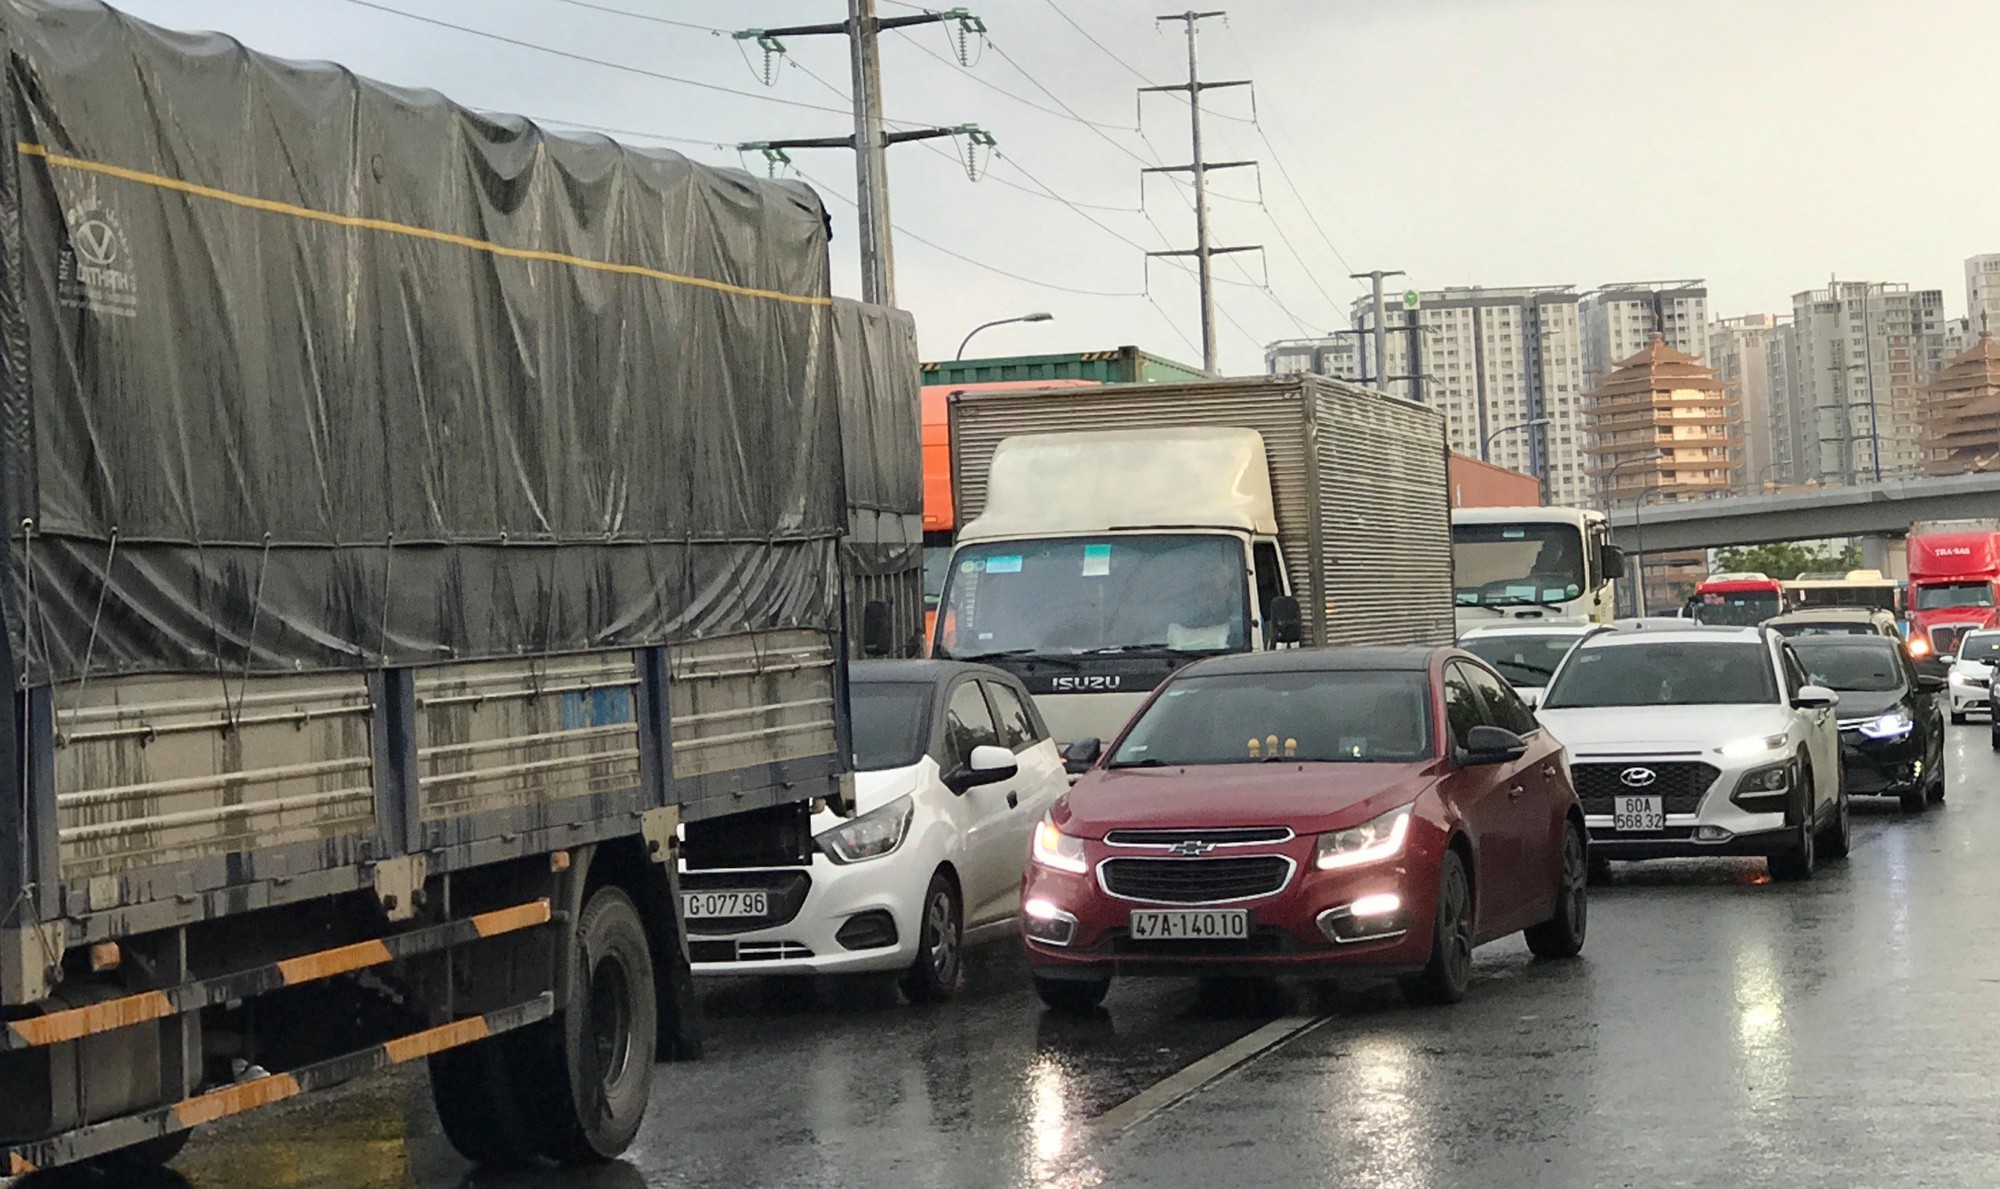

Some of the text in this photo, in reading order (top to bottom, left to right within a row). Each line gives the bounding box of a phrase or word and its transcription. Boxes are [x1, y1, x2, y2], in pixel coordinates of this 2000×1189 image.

[1052, 676, 1121, 692] ISUZU
[1626, 798, 1652, 813] 60A
[1136, 914, 1243, 936] 47A-140.10
